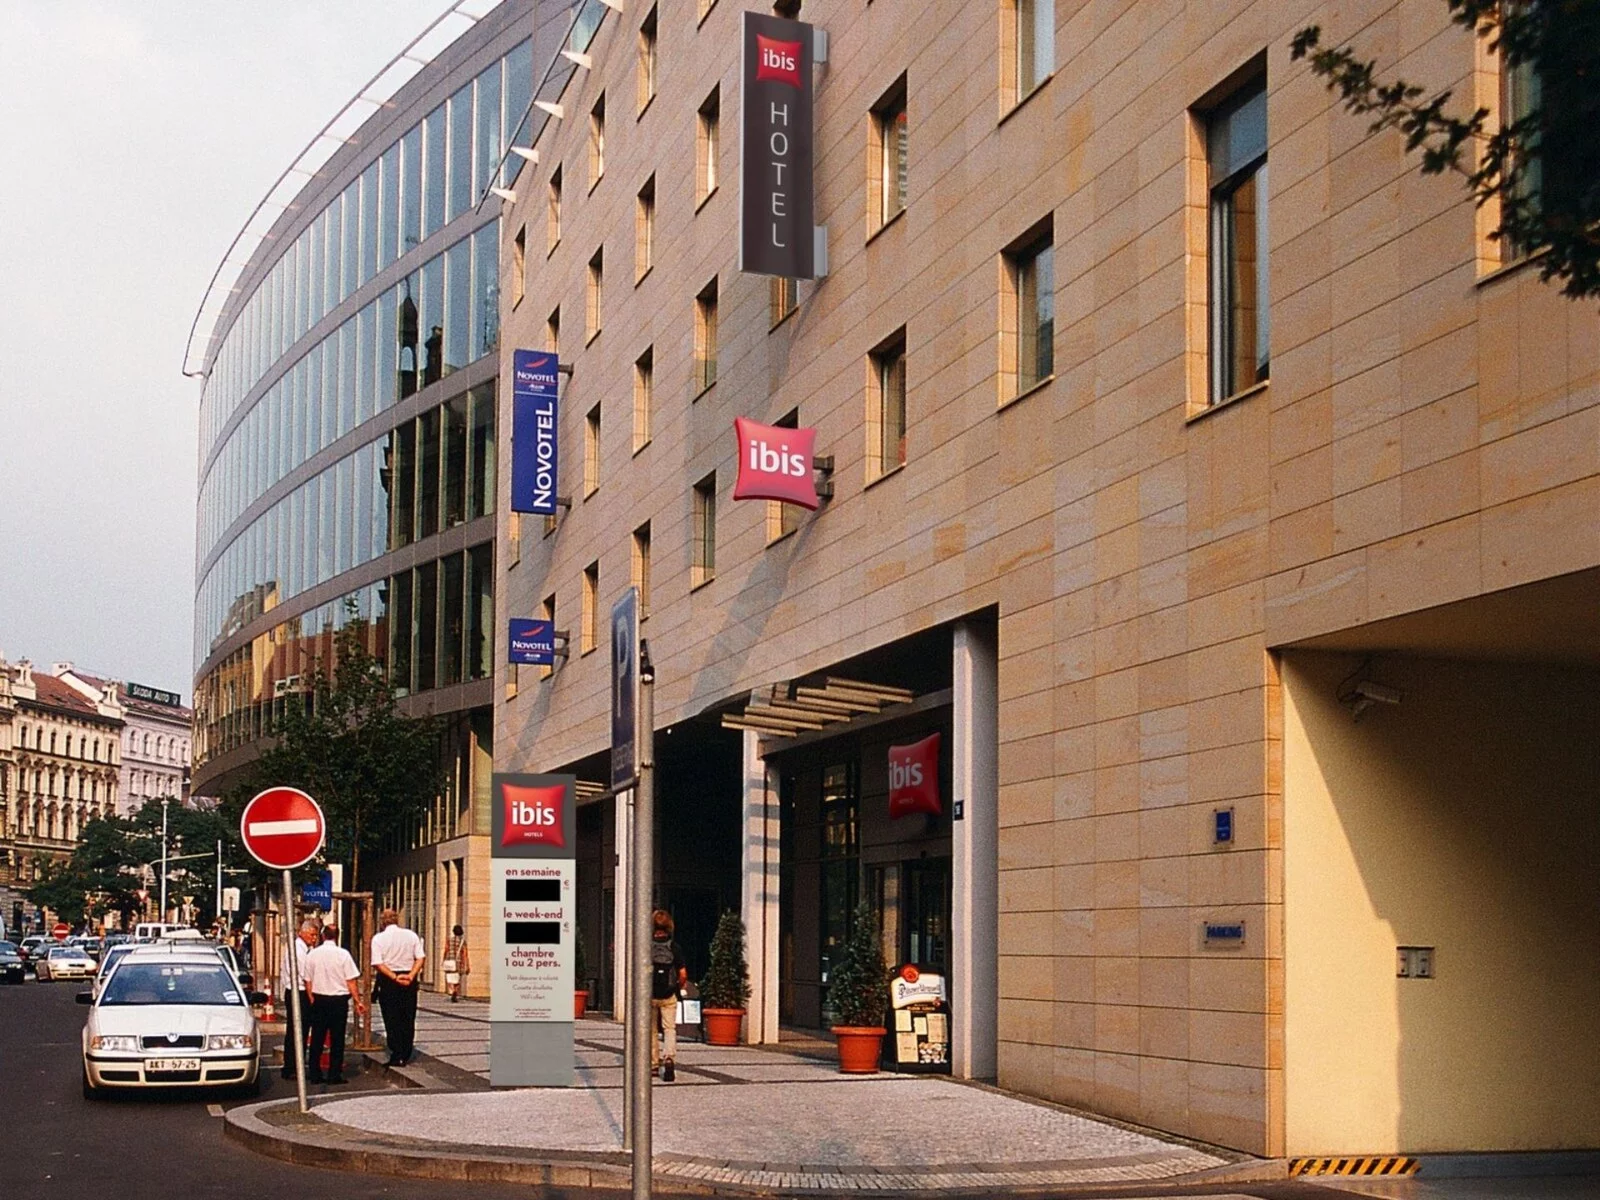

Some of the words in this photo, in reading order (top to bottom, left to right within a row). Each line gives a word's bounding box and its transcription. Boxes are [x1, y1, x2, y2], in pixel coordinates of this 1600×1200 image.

[763, 48, 796, 72] ibis
[770, 101, 789, 248] HOTEL
[516, 370, 556, 383] NOVOTEL
[533, 402, 553, 508] NOVOTEL
[750, 439, 806, 477] ibis
[512, 640, 552, 651] NOVOTEL
[889, 757, 923, 790] ibis
[512, 800, 555, 826] ibis
[505, 868, 518, 876] en
[520, 866, 561, 876] semaine
[503, 906, 512, 918] le
[515, 906, 563, 919] week-end
[511, 946, 555, 958] chambre
[505, 957, 509, 967] 1
[527, 957, 533, 967] 2
[536, 960, 561, 970] pers.
